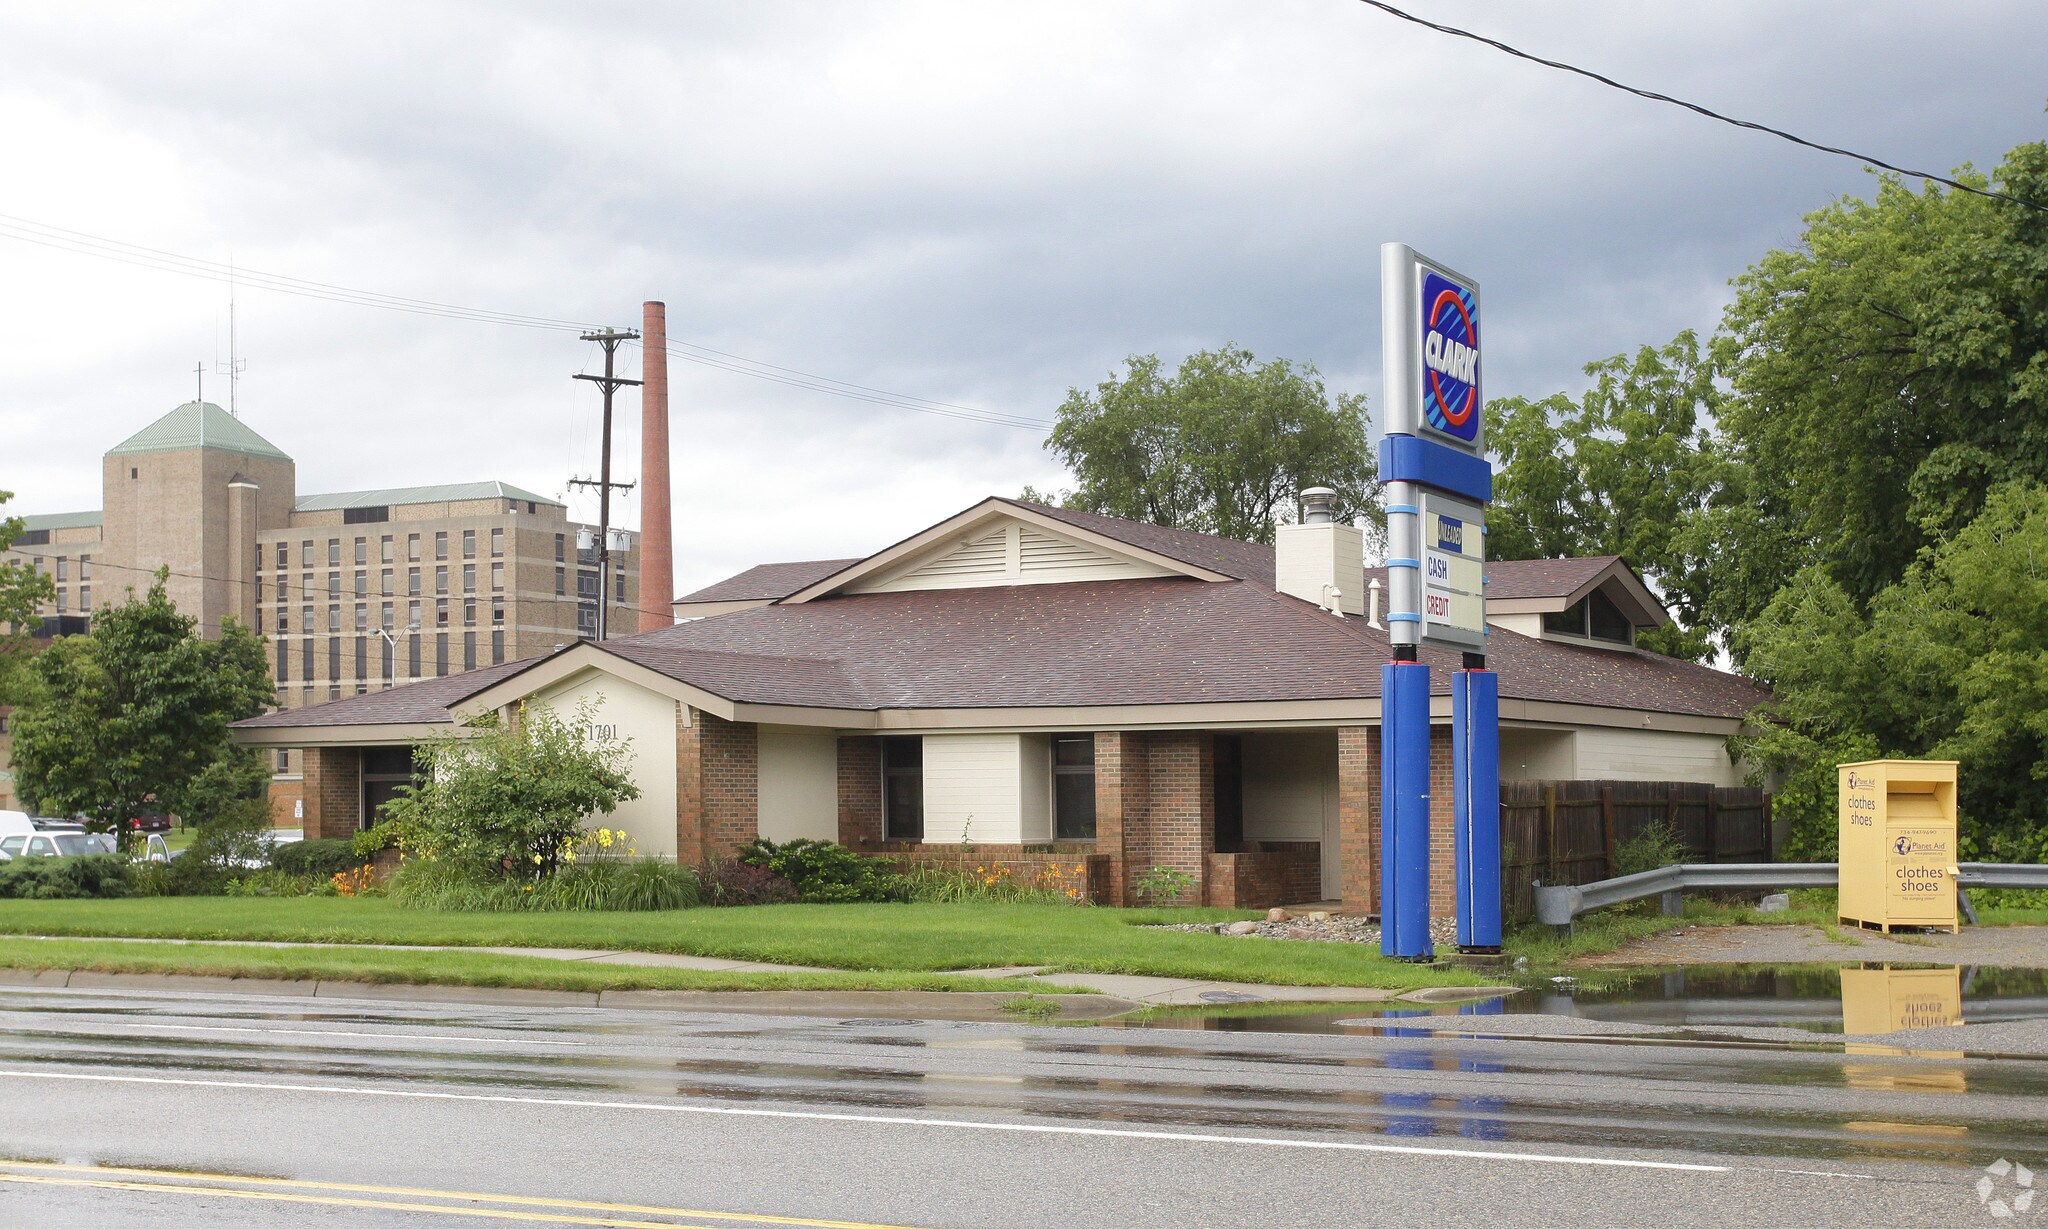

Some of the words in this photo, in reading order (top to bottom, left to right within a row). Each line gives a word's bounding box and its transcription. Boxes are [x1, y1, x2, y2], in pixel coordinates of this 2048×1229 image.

[1426, 330, 1478, 386] CLARK
[1428, 556, 1448, 580] CASH
[1427, 594, 1449, 617] CREDIT
[589, 724, 618, 741] 1701
[1848, 795, 1875, 811] clothes
[1851, 811, 1872, 826] shoes
[1912, 842, 1932, 850] Planet
[1933, 842, 1945, 850] Aid
[1896, 865, 1943, 878] clothes
[1901, 879, 1938, 892] shoes
